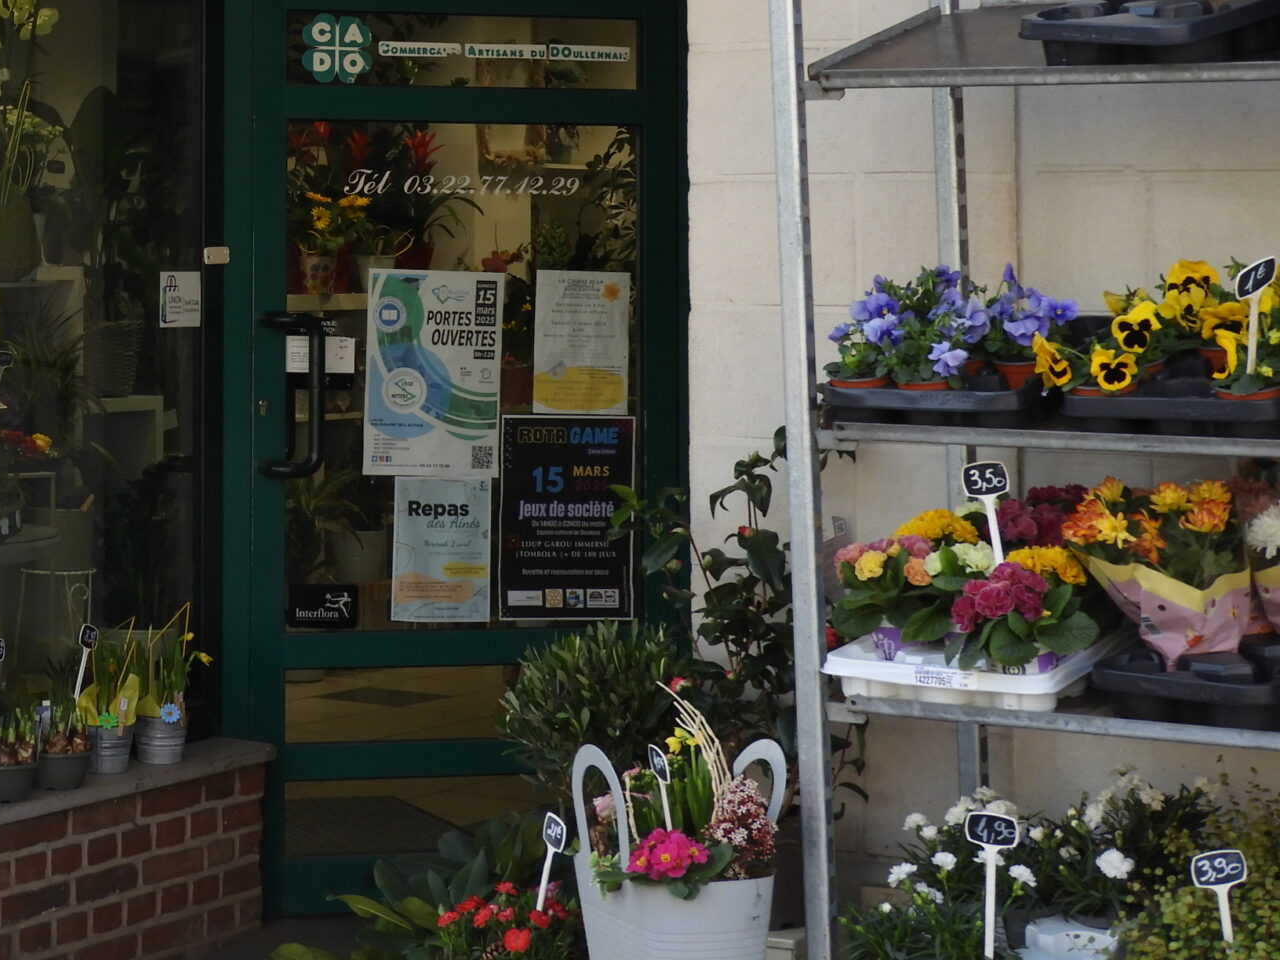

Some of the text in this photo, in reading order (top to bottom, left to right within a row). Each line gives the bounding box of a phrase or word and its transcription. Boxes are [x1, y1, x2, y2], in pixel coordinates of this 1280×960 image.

[343, 169, 581, 196] Tél 03.22.77.12.29
[477, 290, 496, 304] 15
[426, 310, 472, 326] PORTES
[476, 307, 495, 315] mars
[476, 316, 495, 324] 2025
[432, 329, 497, 347] OUVERTES
[517, 426, 620, 444] ROTA GAME
[532, 465, 565, 493] 15
[573, 466, 610, 477] MARS
[970, 468, 1005, 491] 3,50
[408, 500, 469, 520] Repas
[519, 500, 547, 519] Jeux
[549, 500, 565, 517] de
[427, 519, 446, 529] des
[521, 540, 542, 548] LOUP
[544, 540, 572, 548] GAROU
[296, 608, 339, 618] Interflora
[1197, 857, 1242, 883] 3,90
